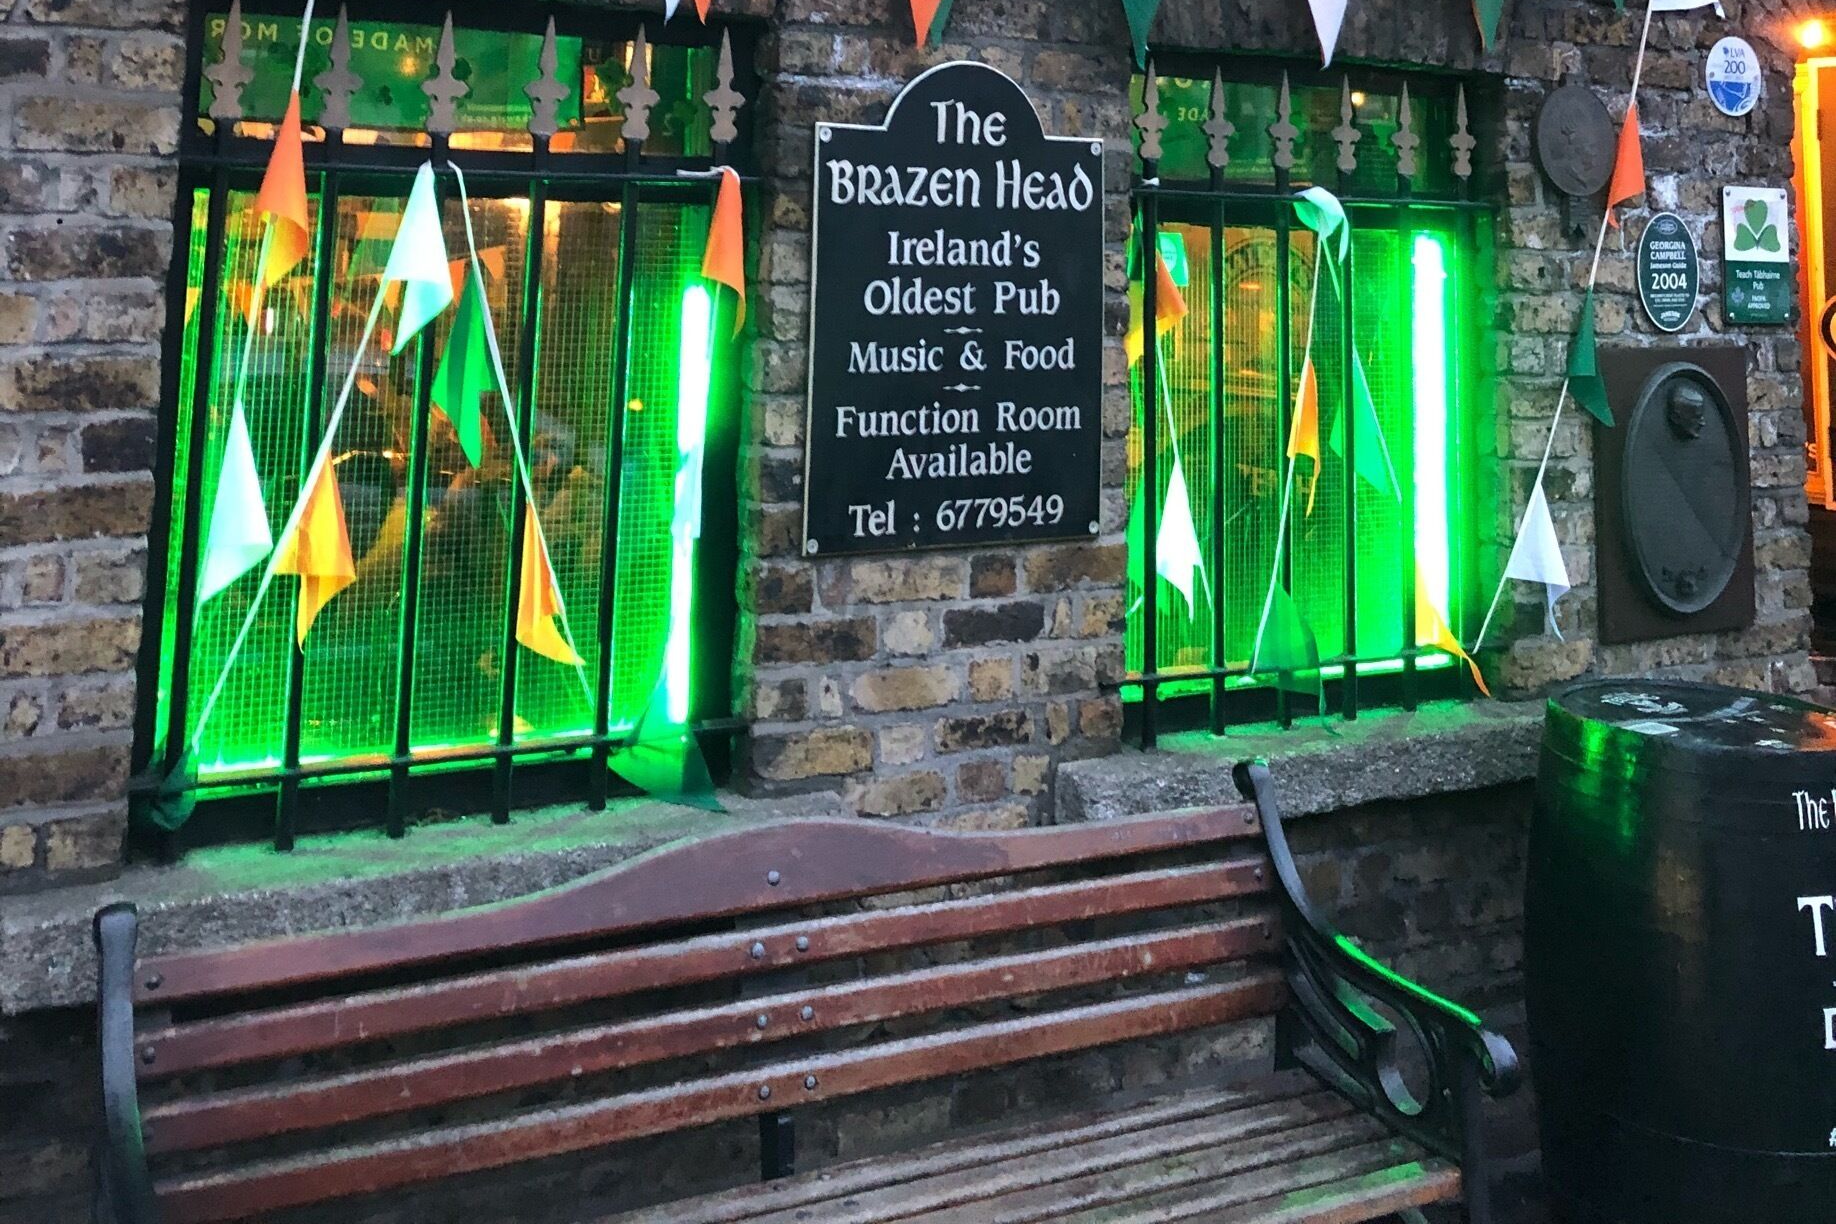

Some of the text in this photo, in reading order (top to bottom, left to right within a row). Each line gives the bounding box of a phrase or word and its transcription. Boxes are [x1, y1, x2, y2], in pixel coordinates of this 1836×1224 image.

[1724, 59, 1746, 75] 200
[1730, 48, 1745, 57] LVA
[930, 99, 1008, 146] The
[887, 228, 1041, 268] Ireland's
[1650, 241, 1686, 250] GEORGINA
[1650, 251, 1687, 260] CAMPBELL
[863, 276, 1061, 315] Oldest Pub
[1651, 272, 1687, 290] 2004
[848, 337, 1076, 373] Music & Food
[835, 401, 1082, 438] Function Room
[885, 441, 1033, 480] Available
[936, 494, 1065, 532] 6779549
[1792, 789, 1830, 831] The
